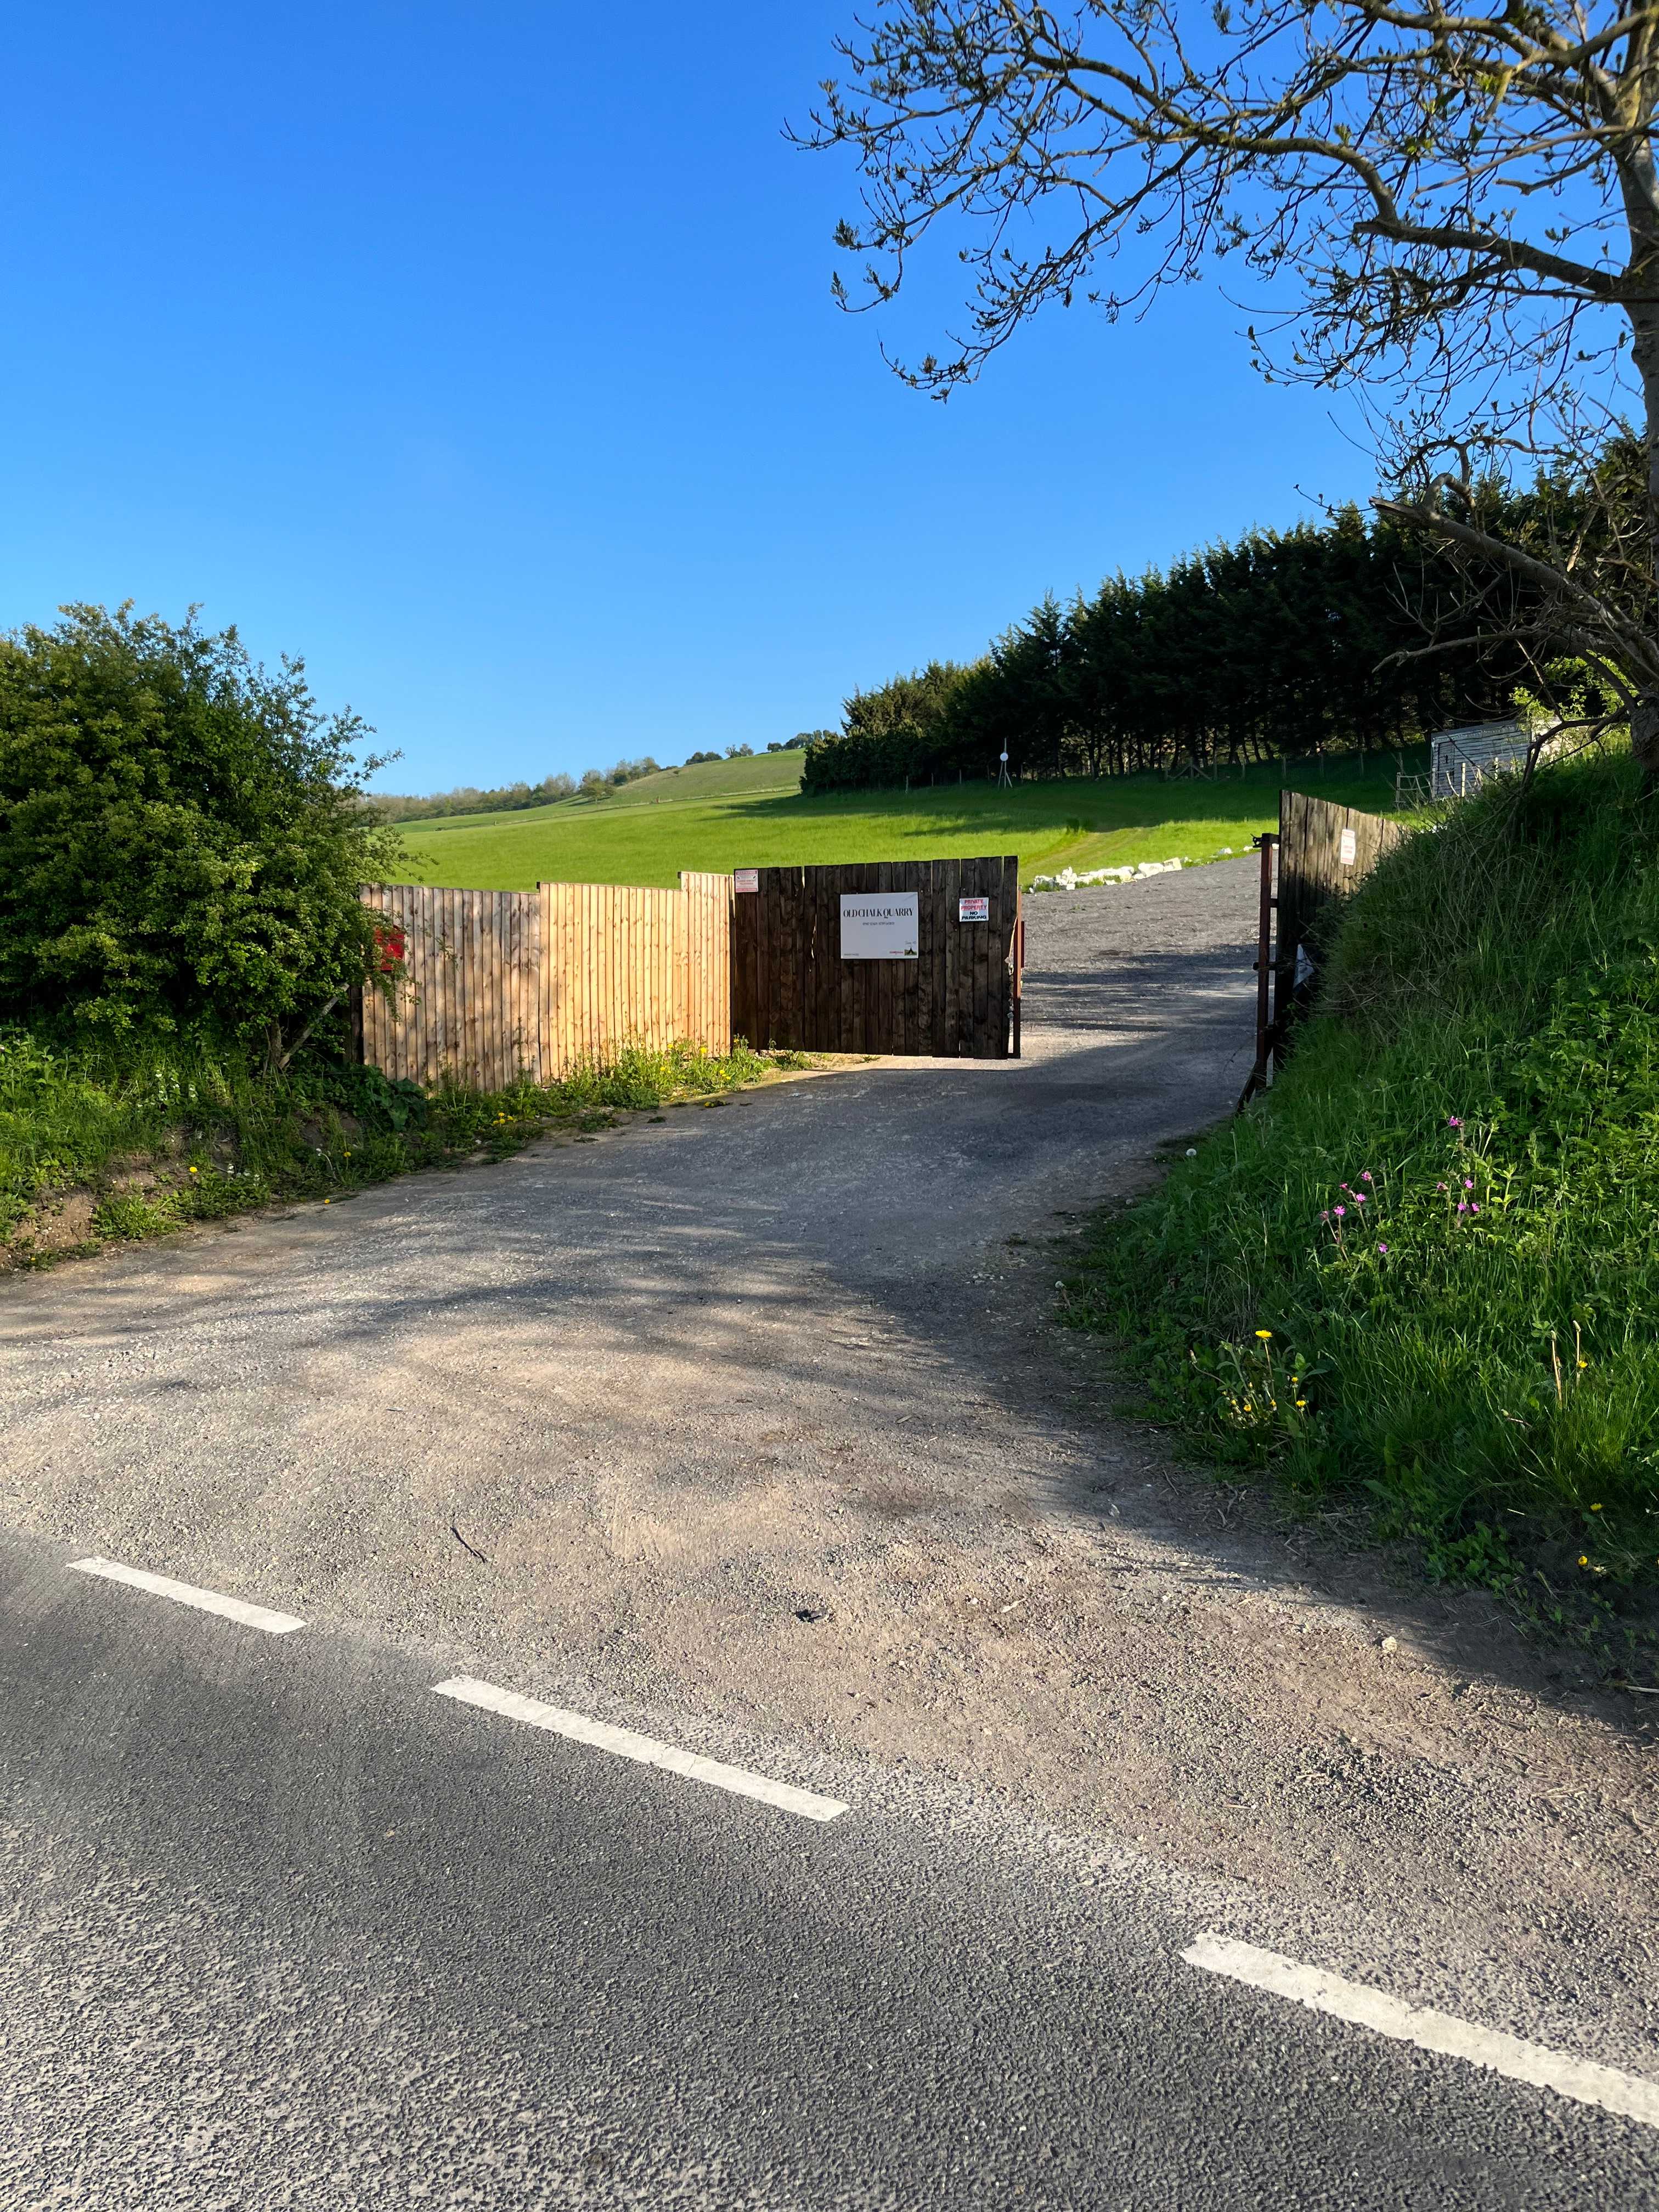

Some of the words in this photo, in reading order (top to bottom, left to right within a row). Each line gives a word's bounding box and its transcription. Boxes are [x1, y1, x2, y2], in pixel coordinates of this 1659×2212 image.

[843, 909, 857, 917] OLD
[858, 909, 882, 917] CHALK
[883, 908, 913, 918] QUARRY
